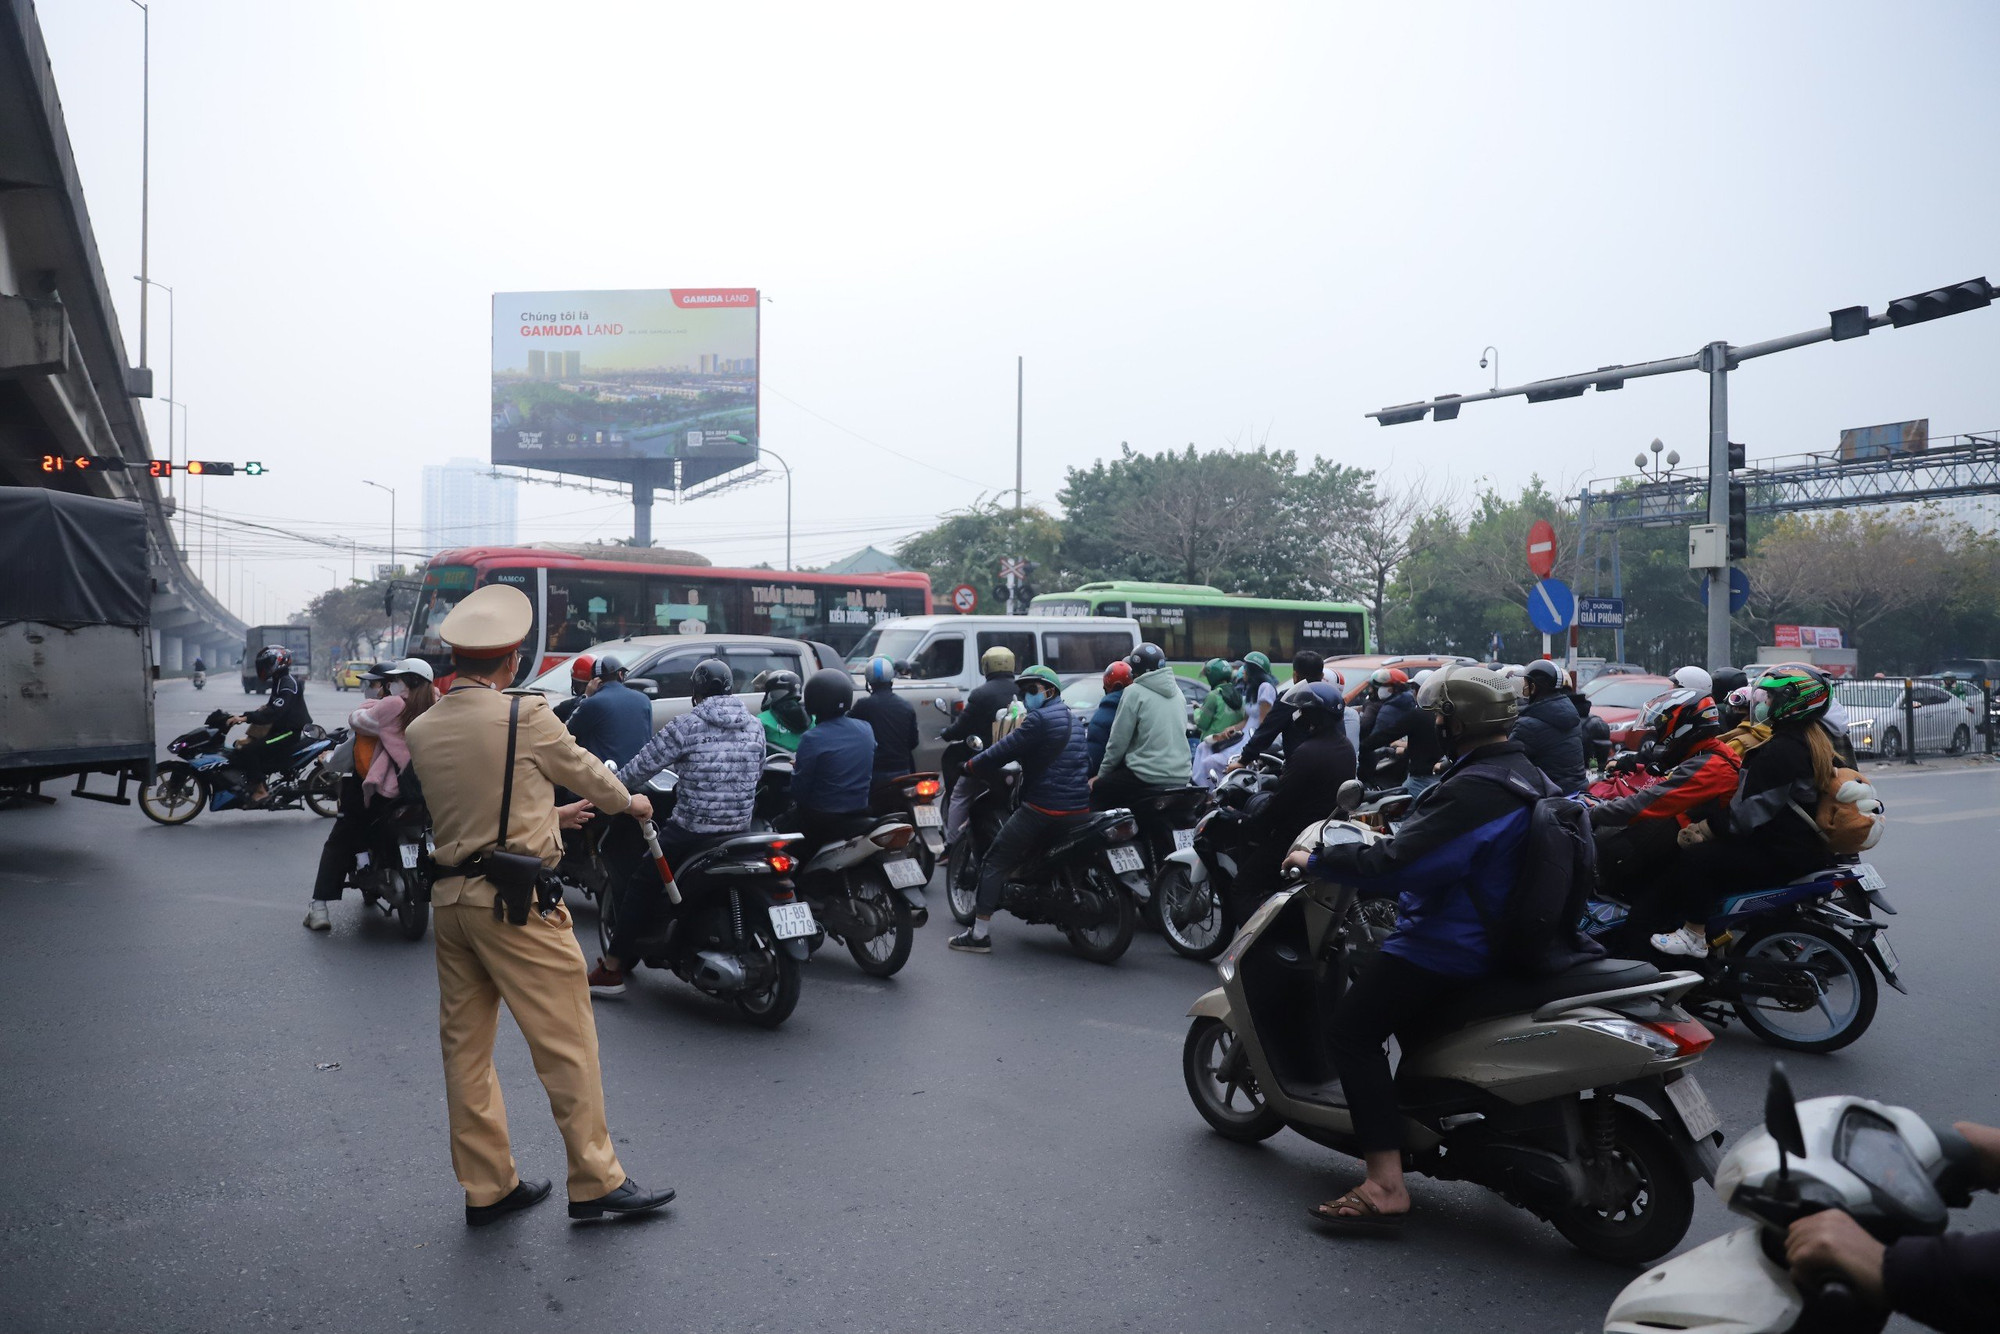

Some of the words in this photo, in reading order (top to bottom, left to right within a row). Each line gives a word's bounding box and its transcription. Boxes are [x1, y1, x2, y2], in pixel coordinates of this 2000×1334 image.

[682, 295, 723, 303] GAMUDA
[725, 294, 749, 303] LAND
[520, 312, 557, 322] Chúng
[560, 311, 576, 321] tôi
[579, 311, 589, 320] là
[520, 325, 583, 337] GAMUDA
[587, 323, 624, 336] LAND
[42, 455, 63, 472] 21
[149, 461, 171, 477] 21
[497, 575, 525, 583] SAMCO
[751, 585, 782, 603] THÁI
[847, 588, 864, 607] HÀ
[829, 605, 846, 623] KIẾN
[1581, 609, 1596, 623] GIẢI
[1597, 610, 1622, 624] PHÓNG
[776, 905, 806, 922] 17-B9
[776, 918, 814, 937] 247.79
